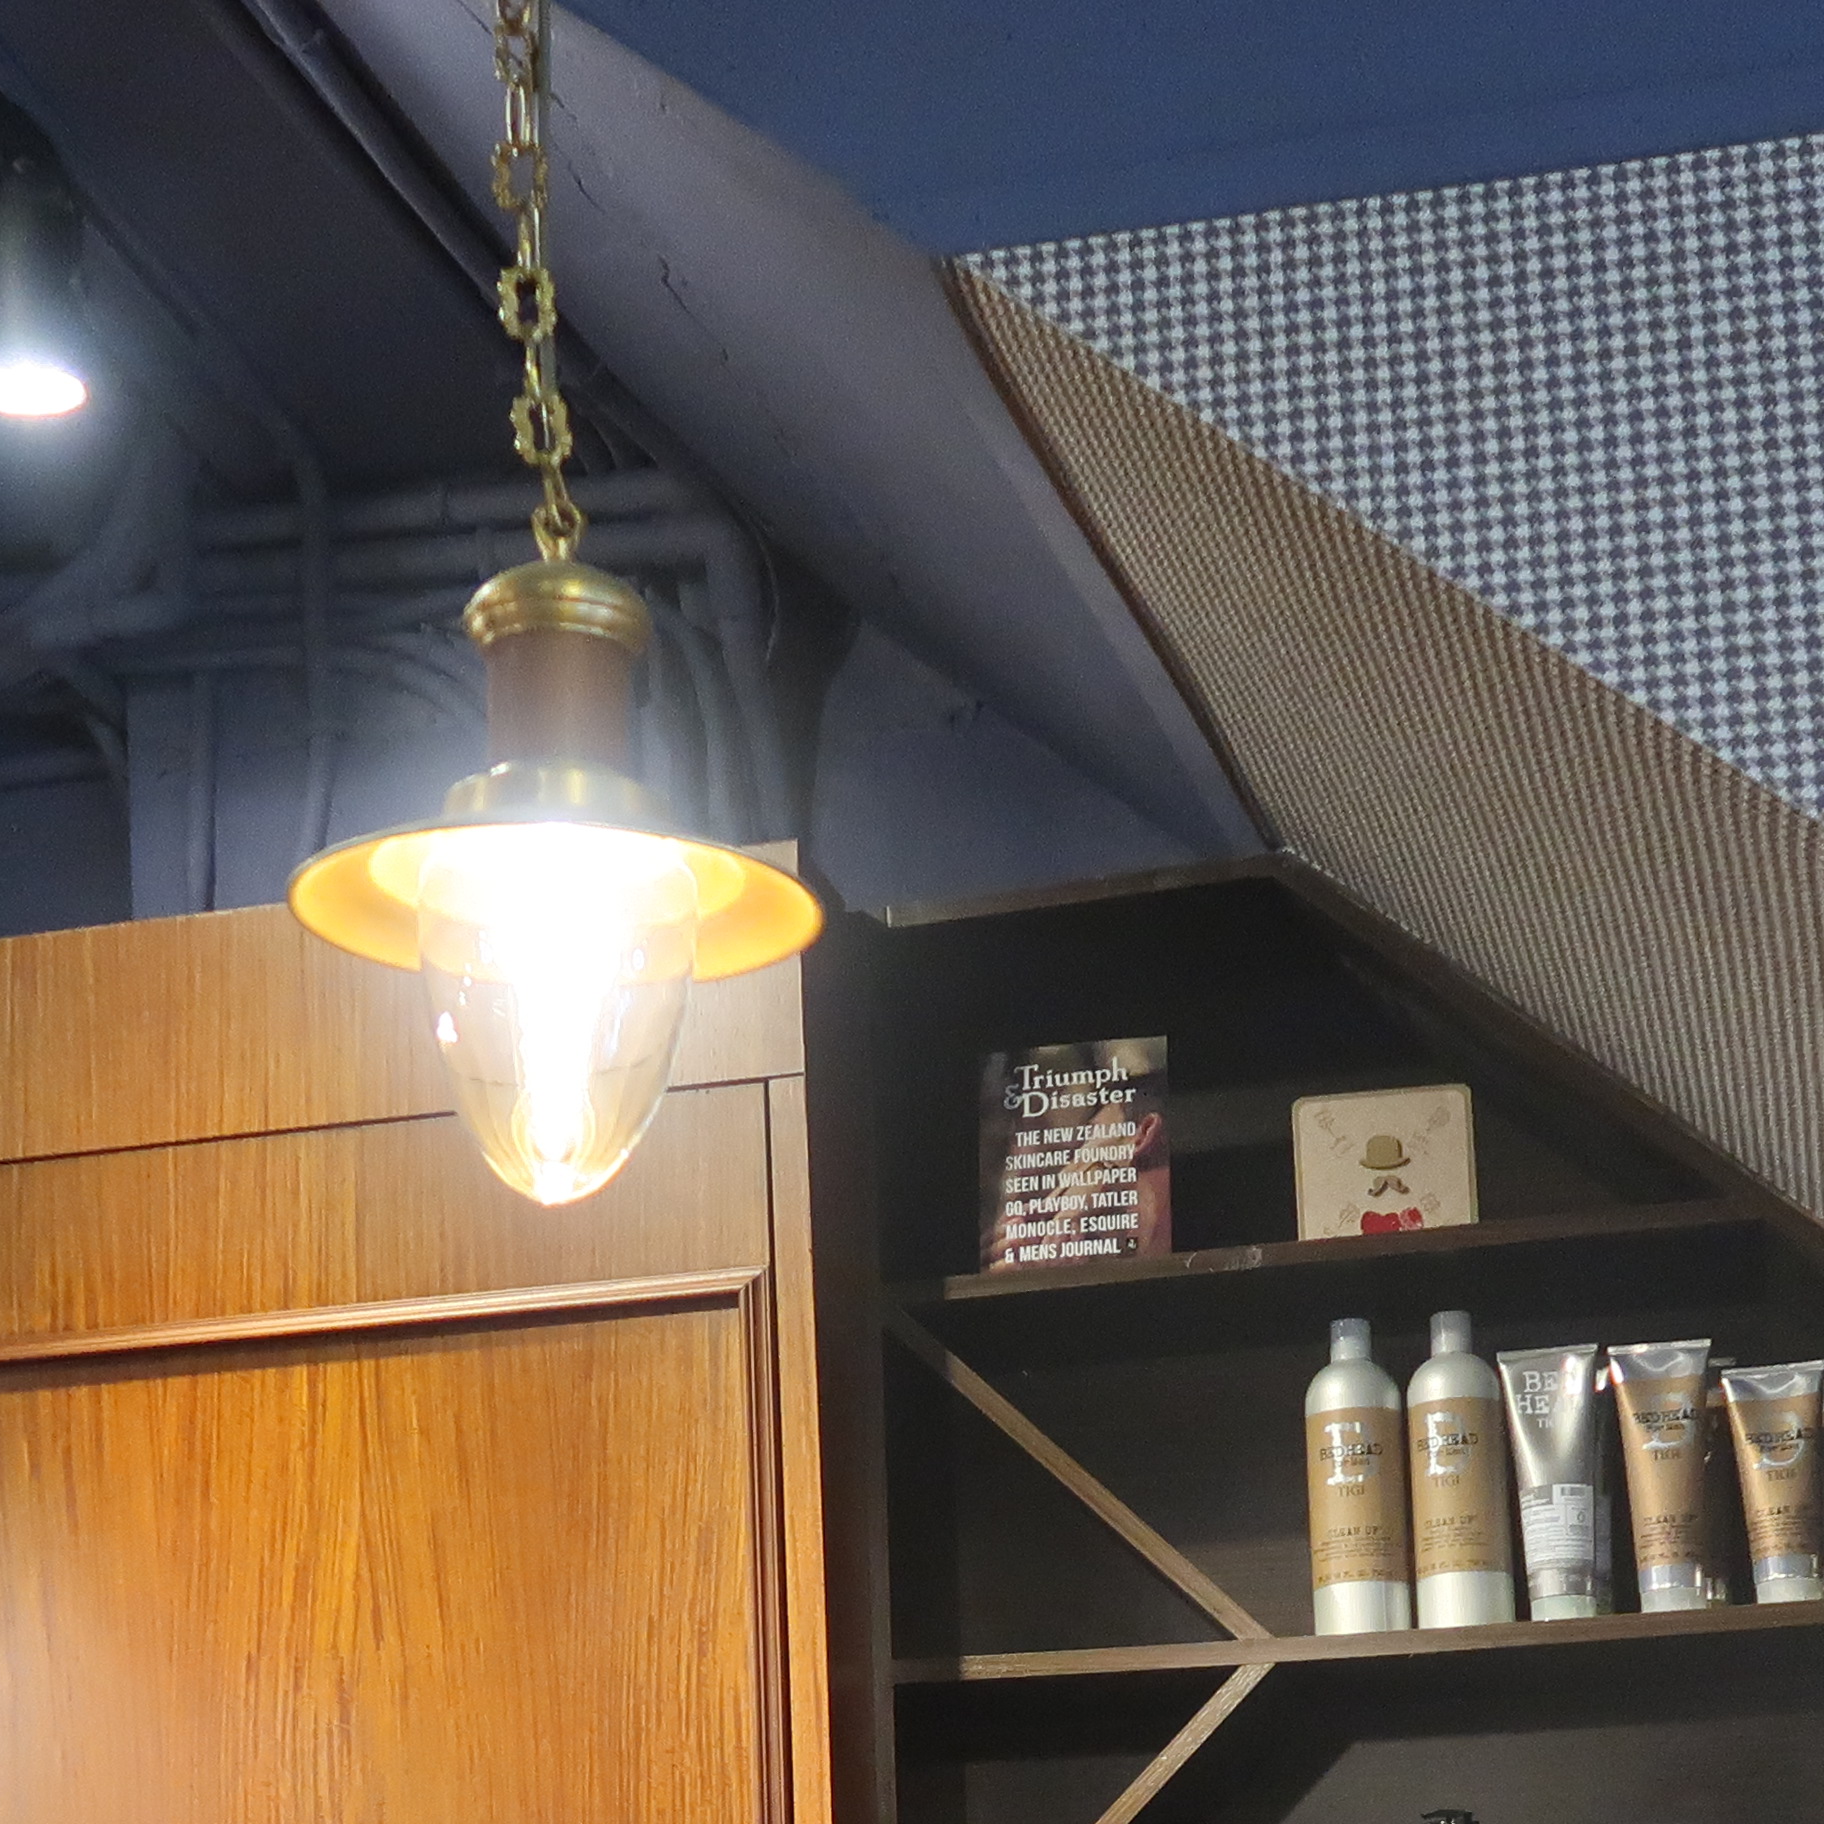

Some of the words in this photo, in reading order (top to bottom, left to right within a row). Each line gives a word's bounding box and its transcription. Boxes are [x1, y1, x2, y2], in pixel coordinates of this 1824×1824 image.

[1014, 1056, 1128, 1090] Triumph
[1022, 1087, 1136, 1118] Disaster
[1015, 1131, 1040, 1148] THE
[1043, 1127, 1073, 1144] NEW
[1076, 1121, 1136, 1141] ZEALAND
[1005, 1150, 1070, 1171] SKINCARE
[1074, 1144, 1136, 1163] FOUNDRY
[1005, 1175, 1039, 1194] SEEN
[1041, 1174, 1056, 1190] IN
[1058, 1167, 1137, 1188] WALLPAPER
[1029, 1195, 1089, 1215] PLAYBOY,
[1091, 1190, 1138, 1208] TATLER
[1006, 1219, 1076, 1240] MONOCLE,
[1080, 1213, 1139, 1233] ESQUIRE
[1004, 1247, 1015, 1264] &
[1019, 1244, 1057, 1262] MENS
[1060, 1238, 1122, 1258] JOURNAL
[1523, 1371, 1568, 1393] BE
